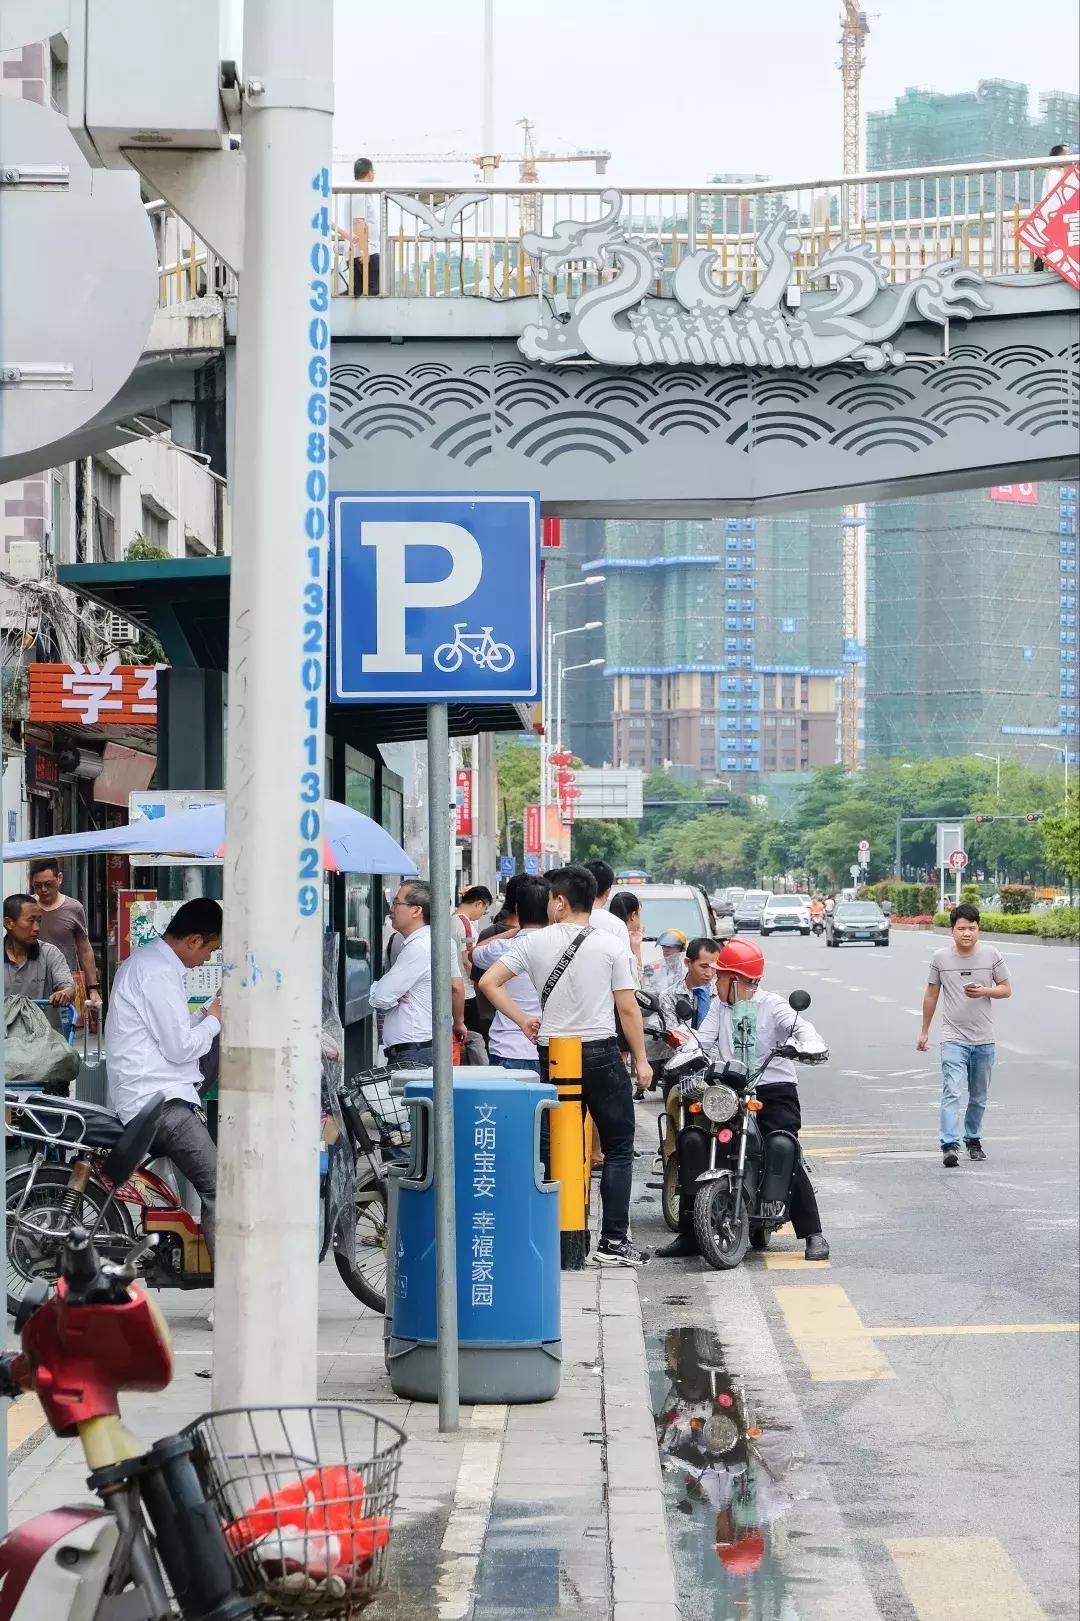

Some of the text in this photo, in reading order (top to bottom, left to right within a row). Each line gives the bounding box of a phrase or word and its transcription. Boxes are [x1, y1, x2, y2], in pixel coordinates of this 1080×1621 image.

[298, 167, 331, 918] 44030668001320113029
[360, 520, 483, 673] P
[471, 1103, 497, 1307] 文明宝安 幸福家园
